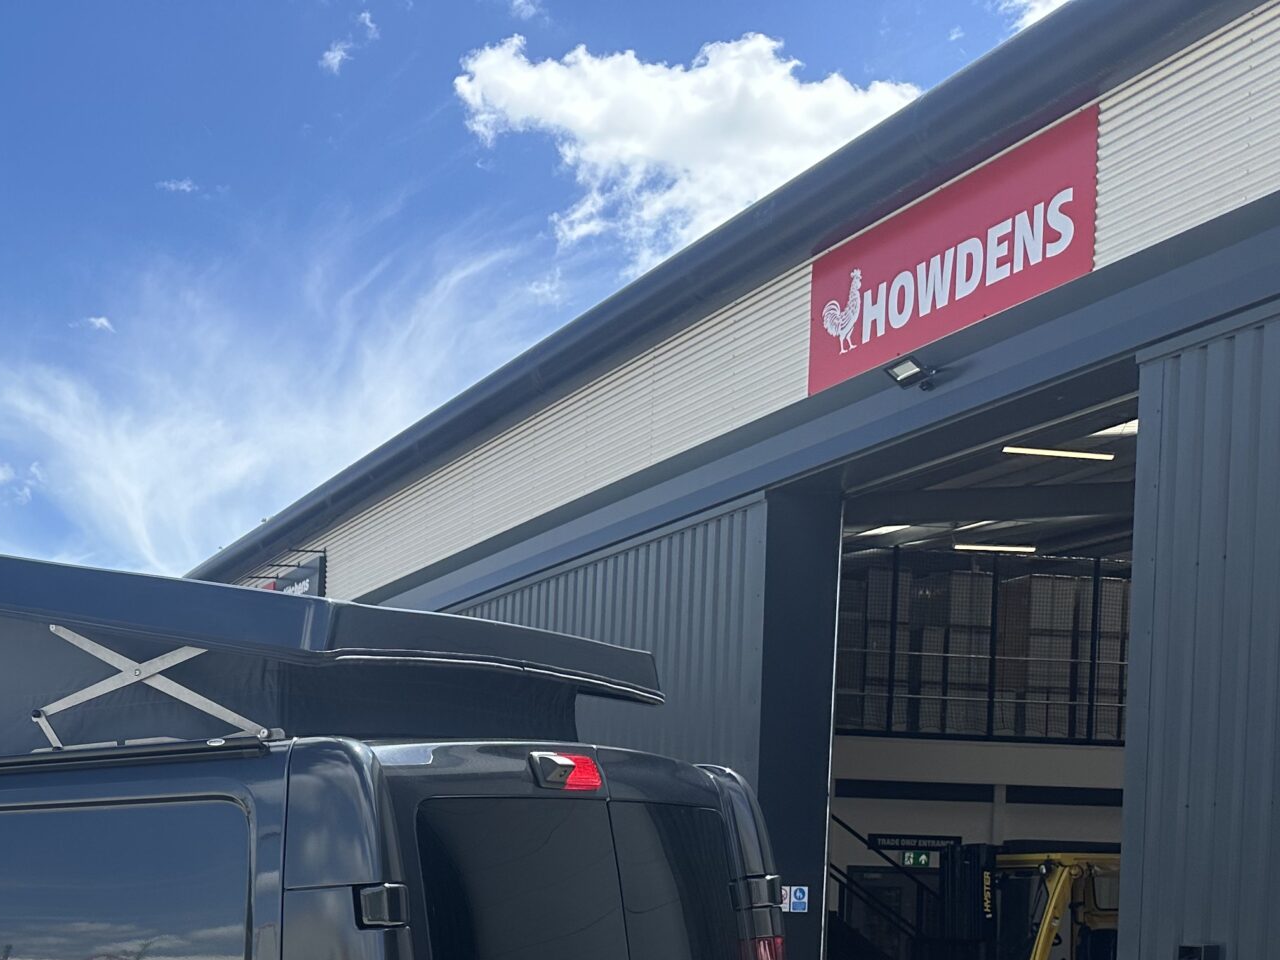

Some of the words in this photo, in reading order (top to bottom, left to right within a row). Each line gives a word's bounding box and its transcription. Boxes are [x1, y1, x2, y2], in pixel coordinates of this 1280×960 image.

[861, 187, 1075, 344] HOWDENS
[877, 838, 900, 846] TRADE
[983, 871, 991, 912] HYSTER
